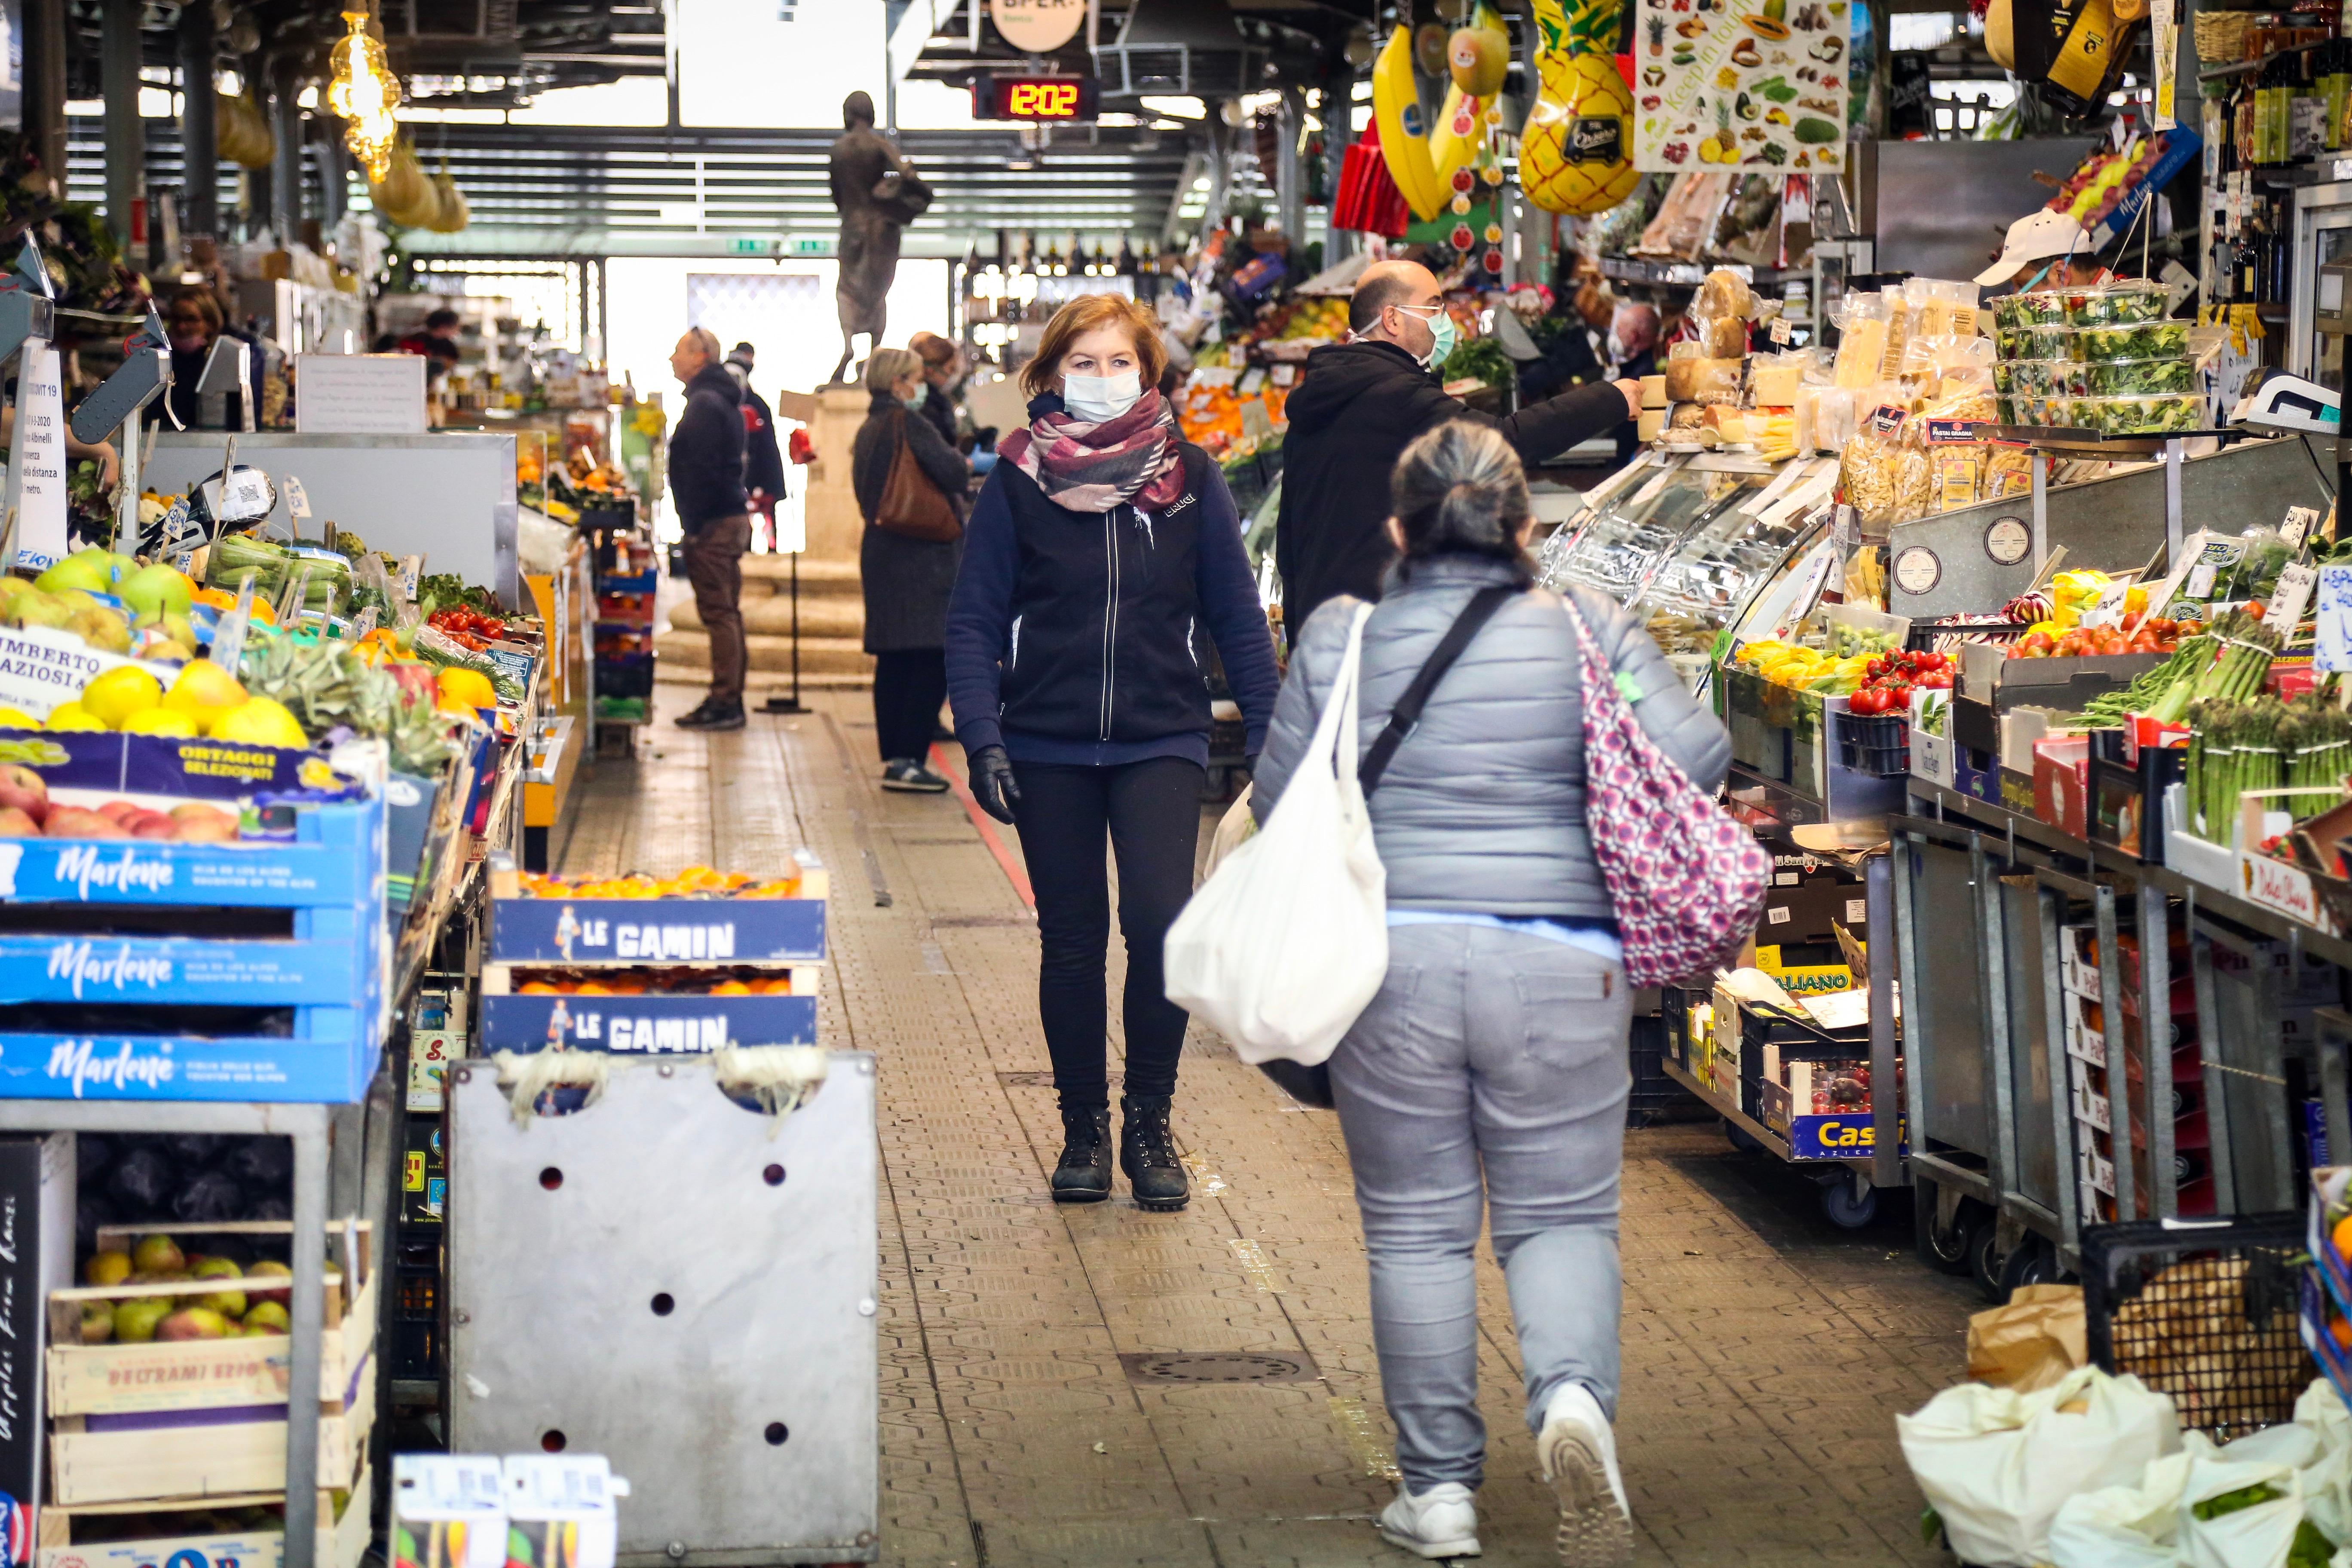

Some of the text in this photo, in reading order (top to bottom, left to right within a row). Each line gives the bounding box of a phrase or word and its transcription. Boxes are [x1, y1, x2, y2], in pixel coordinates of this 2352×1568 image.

[1664, 64, 1705, 111] Keep
[1700, 45, 1719, 65] in
[1011, 85, 1078, 115] 12:02
[48, 384, 57, 397] 19
[31, 467, 57, 478] distanza
[1163, 493, 1196, 518] BRUGI
[0, 636, 100, 674] MBERTO
[0, 658, 86, 690] AZIOSI &
[179, 746, 276, 768] ORTAGGI
[184, 760, 273, 781] SELEZIONATI
[55, 845, 173, 902] Marlene
[582, 920, 735, 961] LE GAMIN
[47, 942, 172, 1000] Marlene
[1773, 972, 1848, 992] ALIANO
[576, 1013, 729, 1053] LE GAMIN
[47, 1039, 173, 1099] Marlene
